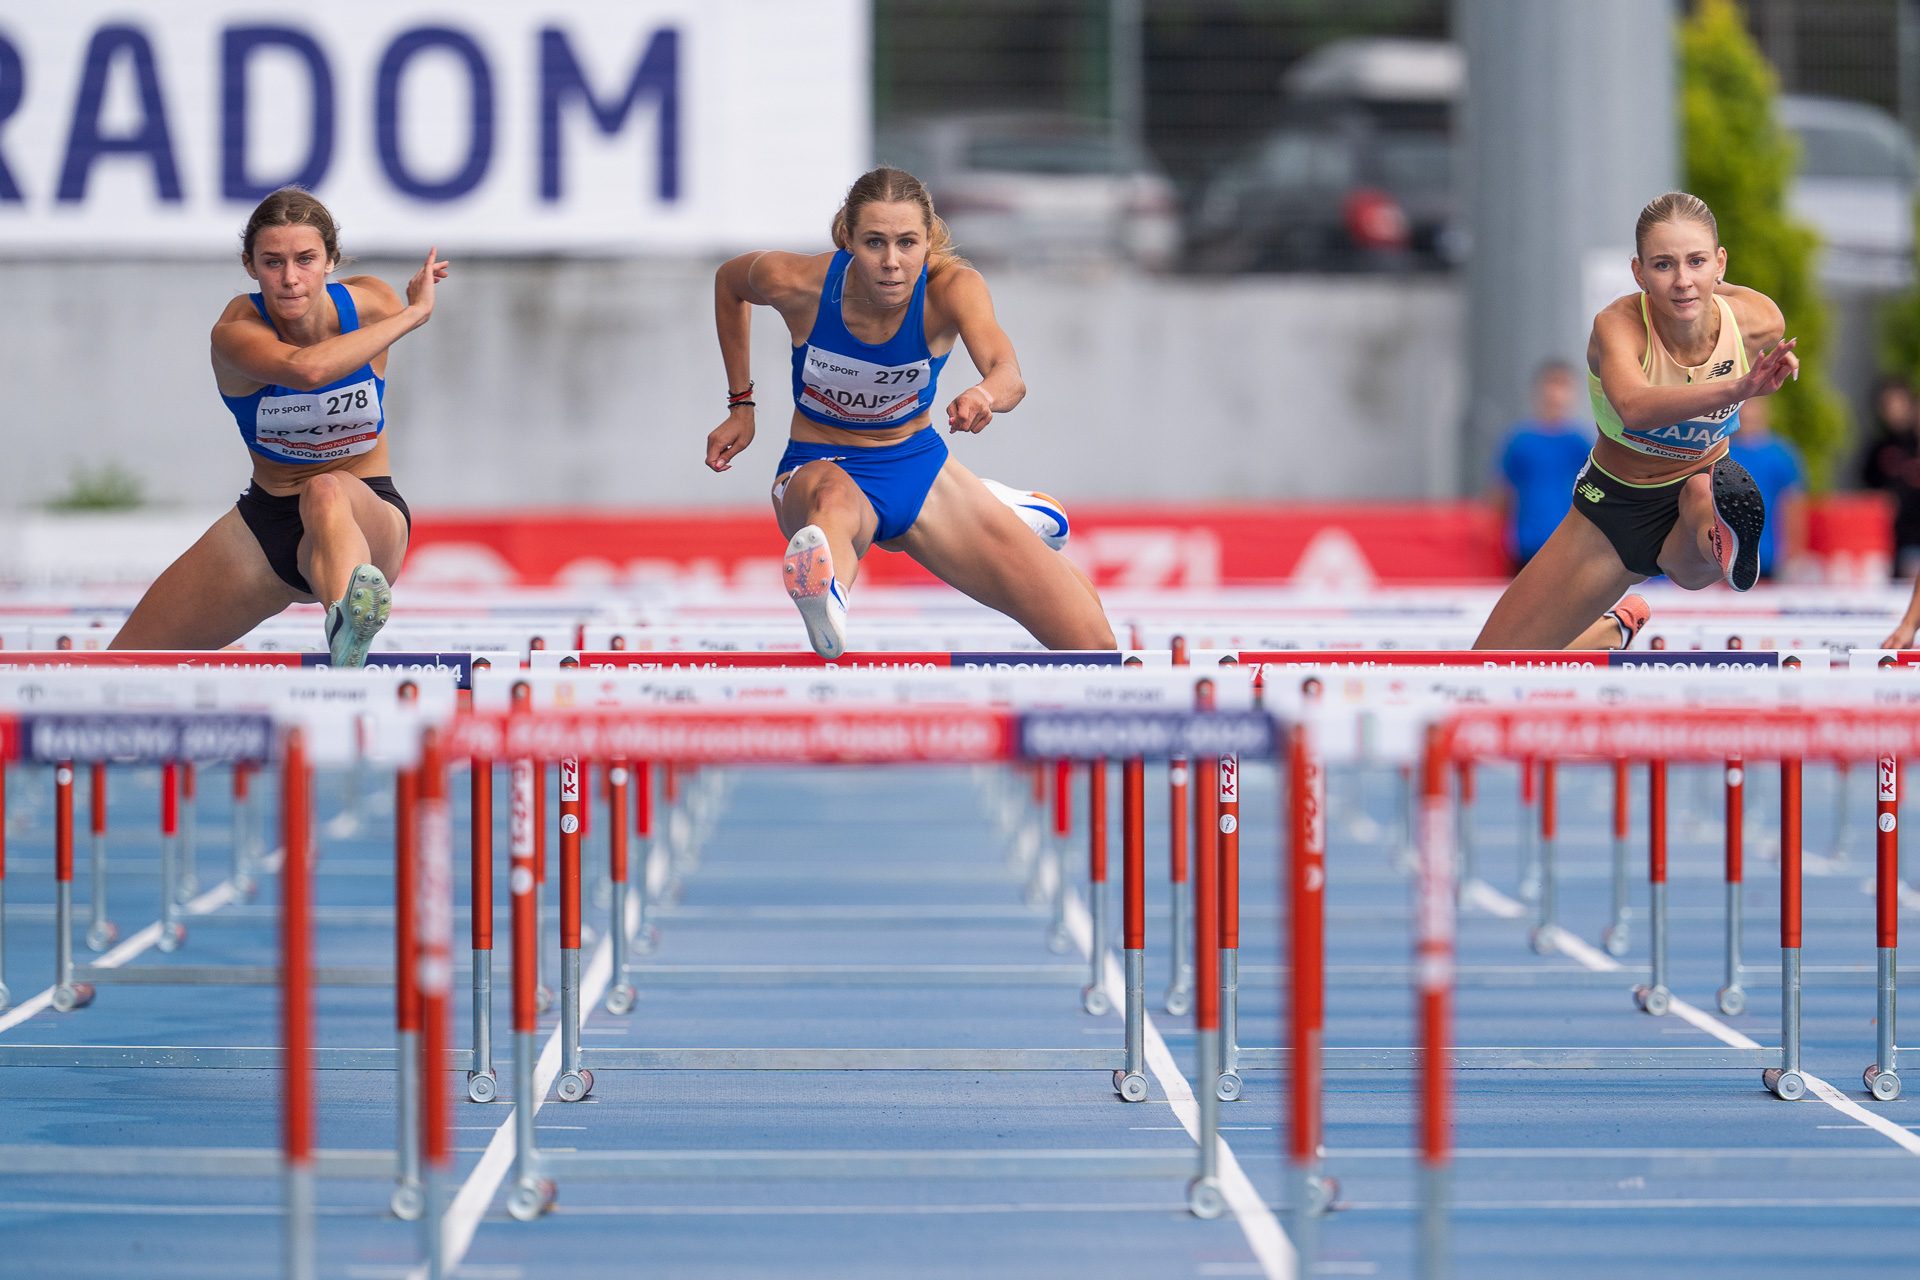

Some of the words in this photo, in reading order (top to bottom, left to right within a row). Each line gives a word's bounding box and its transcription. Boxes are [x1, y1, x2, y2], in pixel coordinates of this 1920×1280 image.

[0, 23, 682, 206] ADOM
[810, 358, 828, 369] TVP
[829, 364, 860, 377] SPORT
[873, 368, 920, 385] 279
[326, 389, 368, 416] 278
[261, 408, 280, 416] TVP
[282, 405, 312, 414] SPORT
[825, 409, 866, 422] RADOM
[282, 448, 322, 459] RADOM
[324, 447, 351, 458] 2024
[1645, 446, 1687, 460] RADOM
